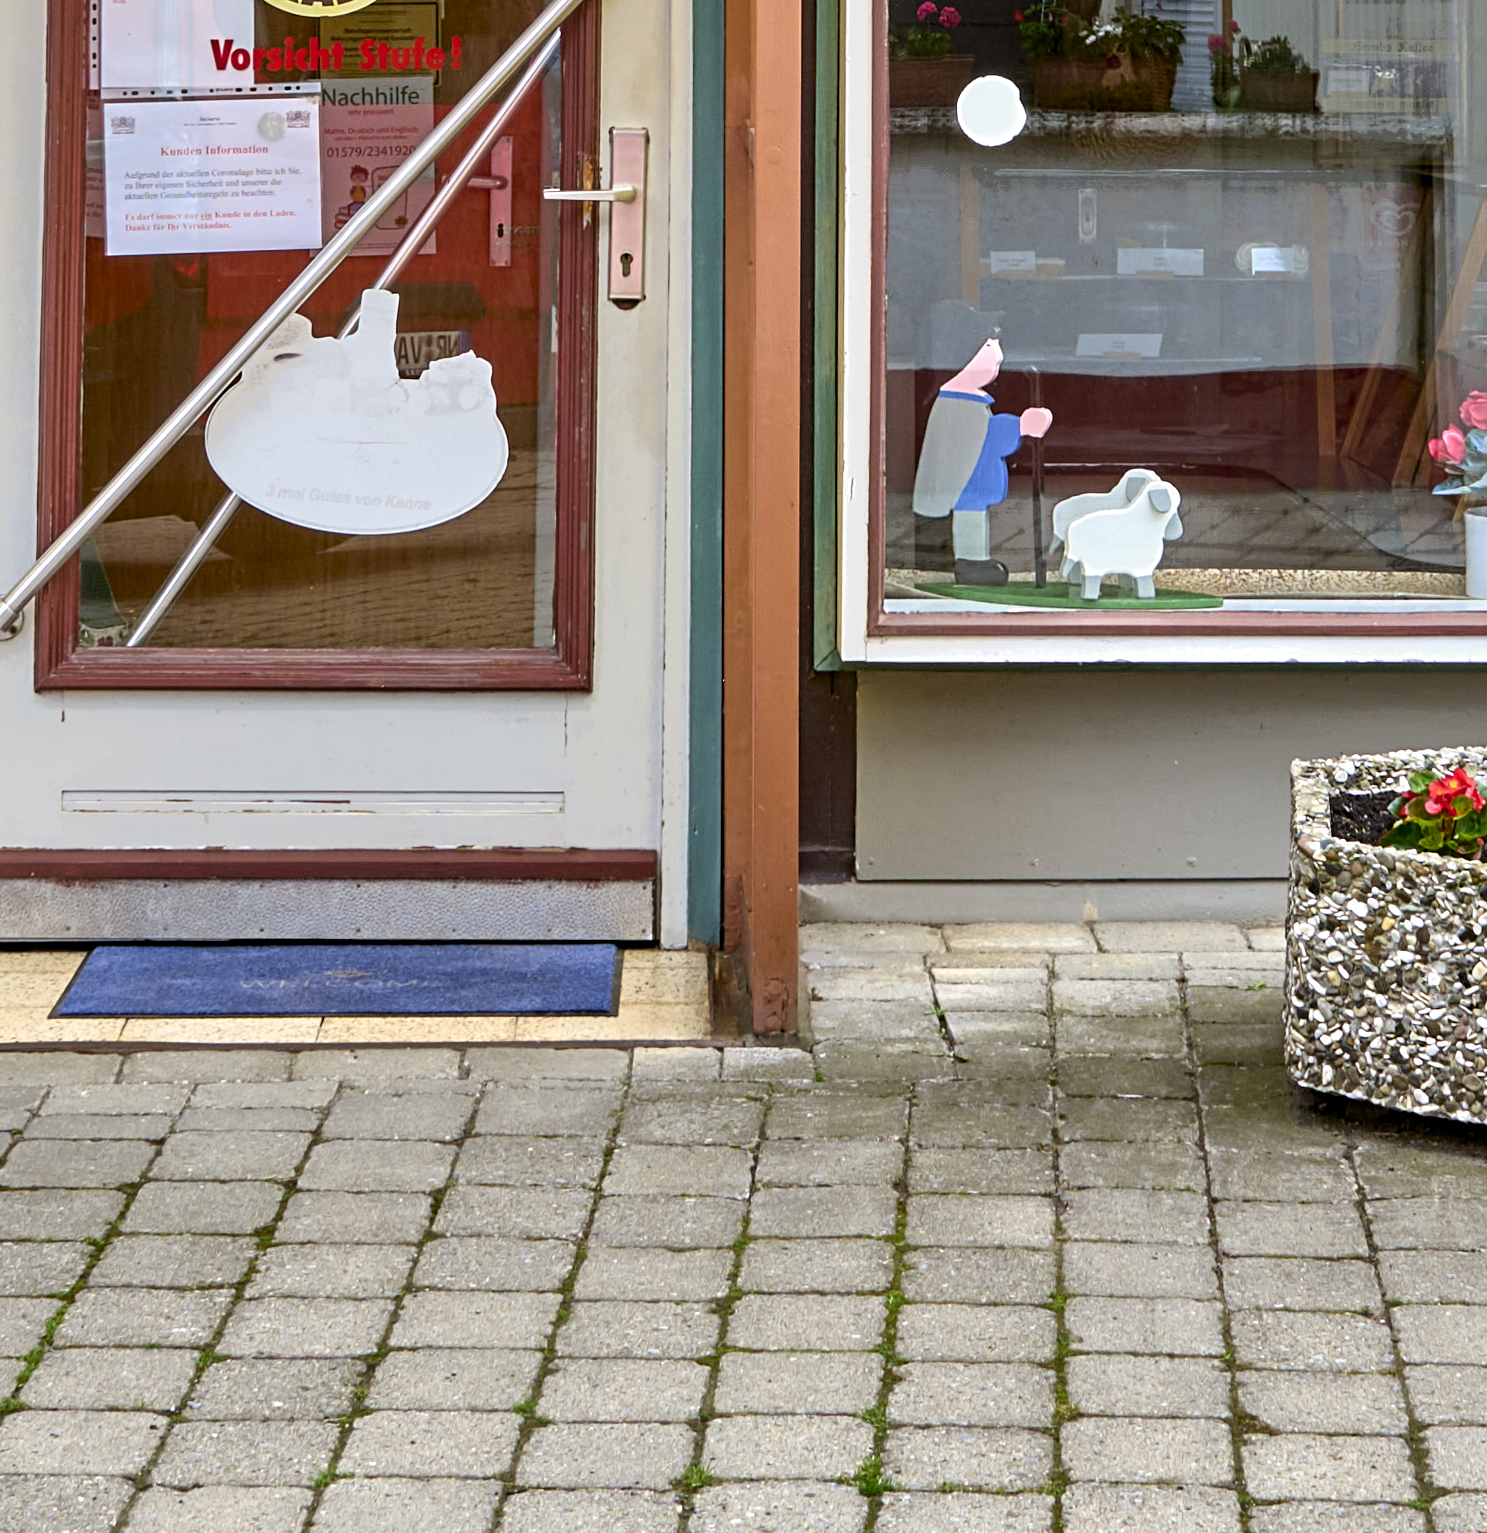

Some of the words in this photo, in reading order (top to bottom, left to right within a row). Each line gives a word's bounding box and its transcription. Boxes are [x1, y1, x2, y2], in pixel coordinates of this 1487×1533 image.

[210, 37, 345, 71] Vorsicht
[322, 86, 420, 107] Nachhilfe
[160, 147, 202, 157] Kunden
[205, 145, 269, 155] Information
[355, 495, 382, 506] von
